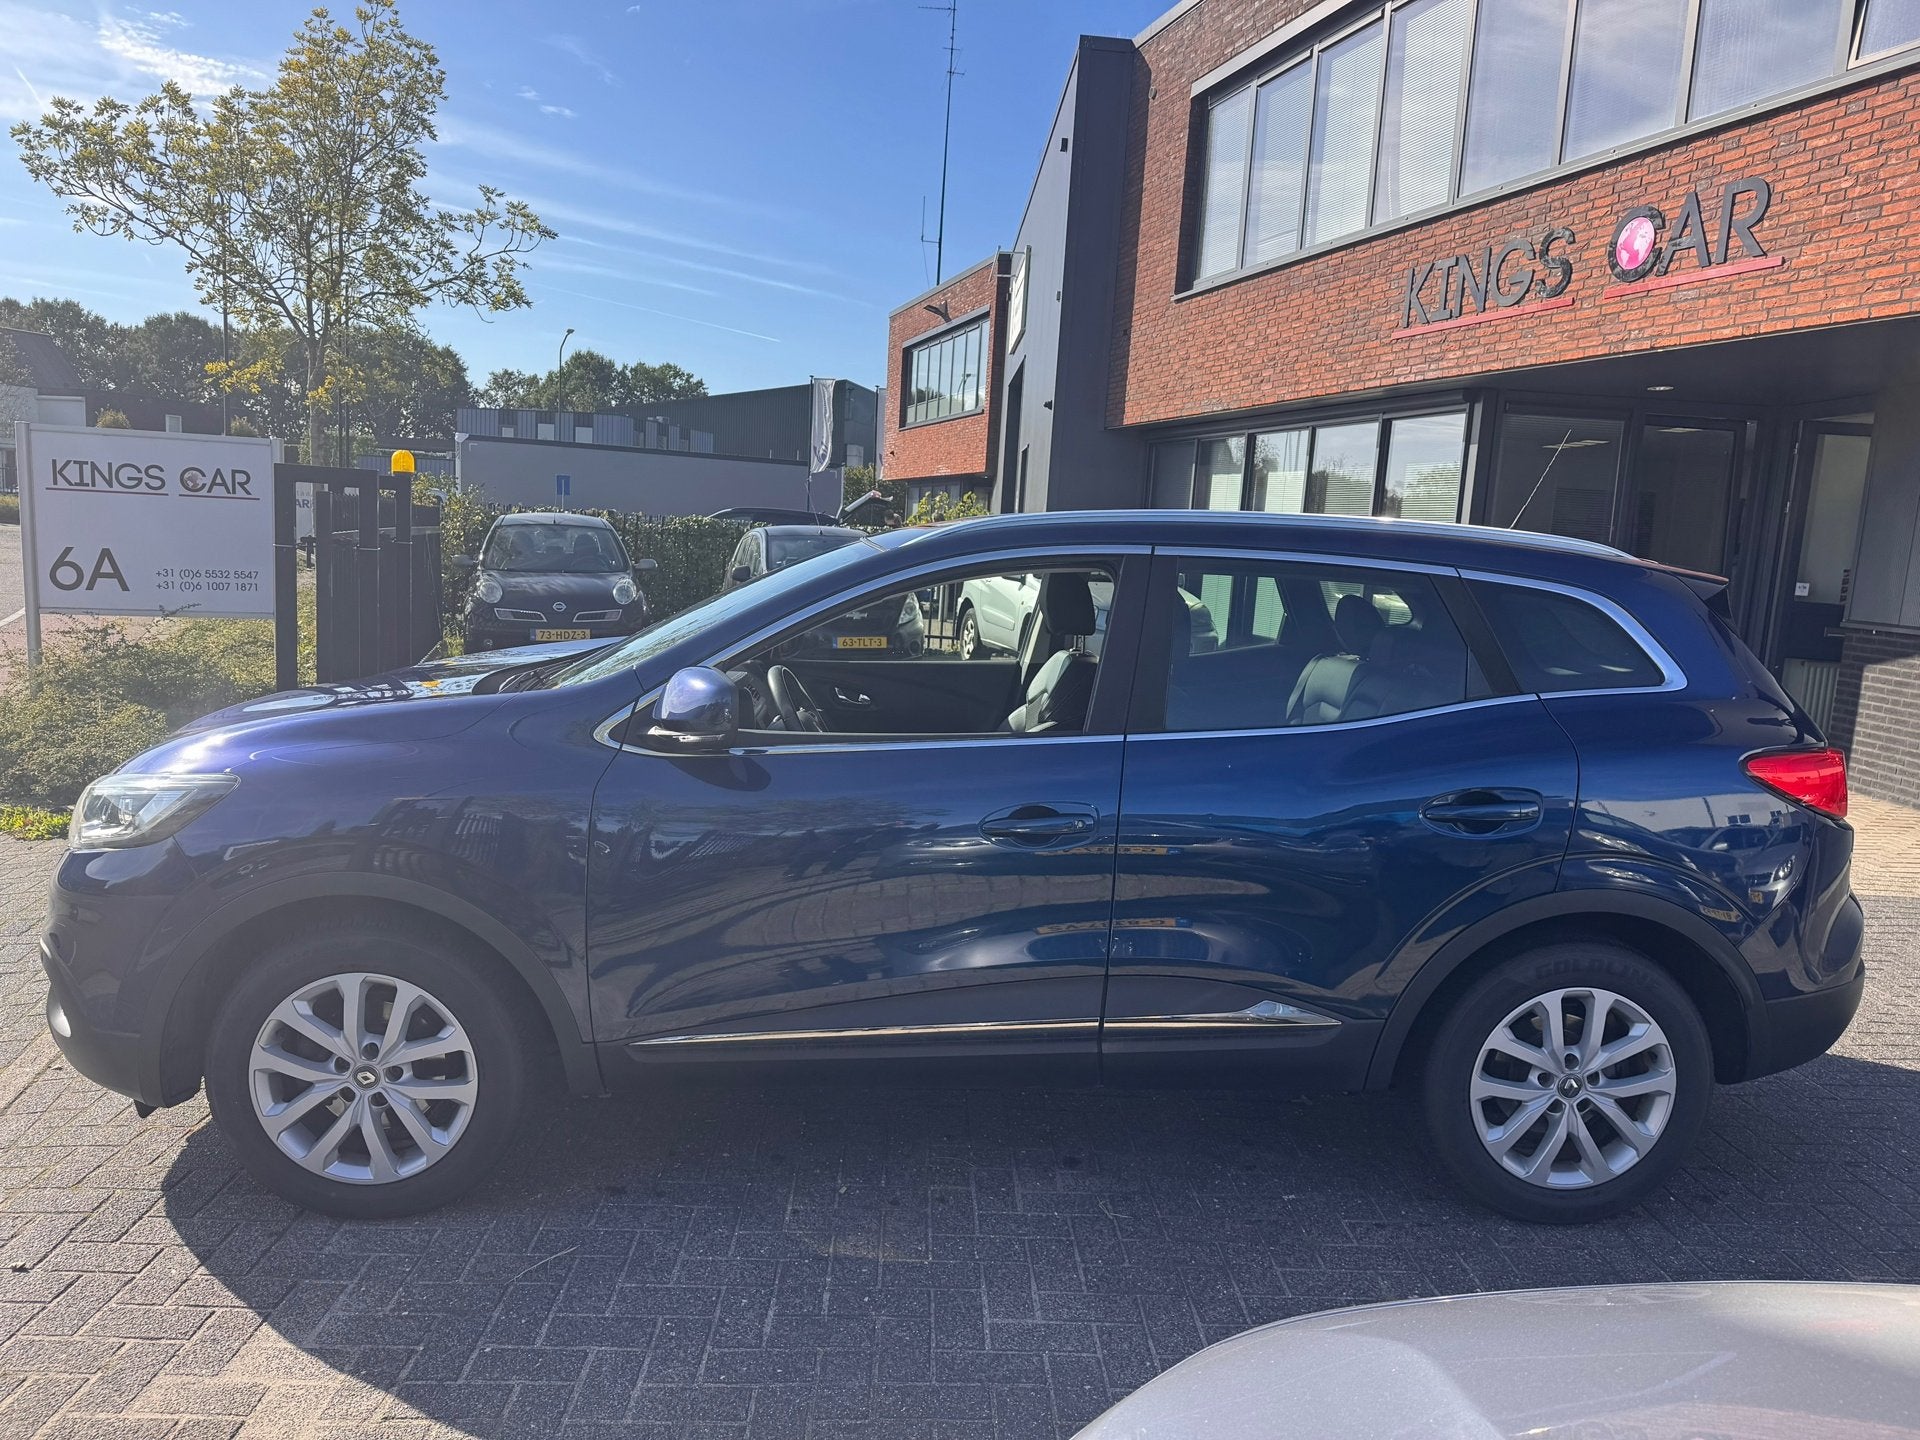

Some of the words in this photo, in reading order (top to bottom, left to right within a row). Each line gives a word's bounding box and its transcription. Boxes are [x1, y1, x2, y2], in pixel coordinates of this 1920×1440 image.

[1402, 226, 1576, 328] KINGS
[1608, 177, 1771, 283] CAR
[51, 458, 166, 490] KINGS
[179, 466, 252, 496] CAR
[49, 546, 130, 592] 6A
[155, 568, 174, 578] +31
[179, 568, 202, 580] (0)6
[204, 569, 231, 579] 5532
[233, 570, 259, 580] 5547
[156, 580, 175, 590] +31
[179, 581, 202, 592] (0)6
[206, 581, 231, 591] 1007
[235, 582, 258, 592] 1871
[539, 630, 587, 640] 73-HDZ-3
[842, 638, 882, 647] 63-TLT-3
